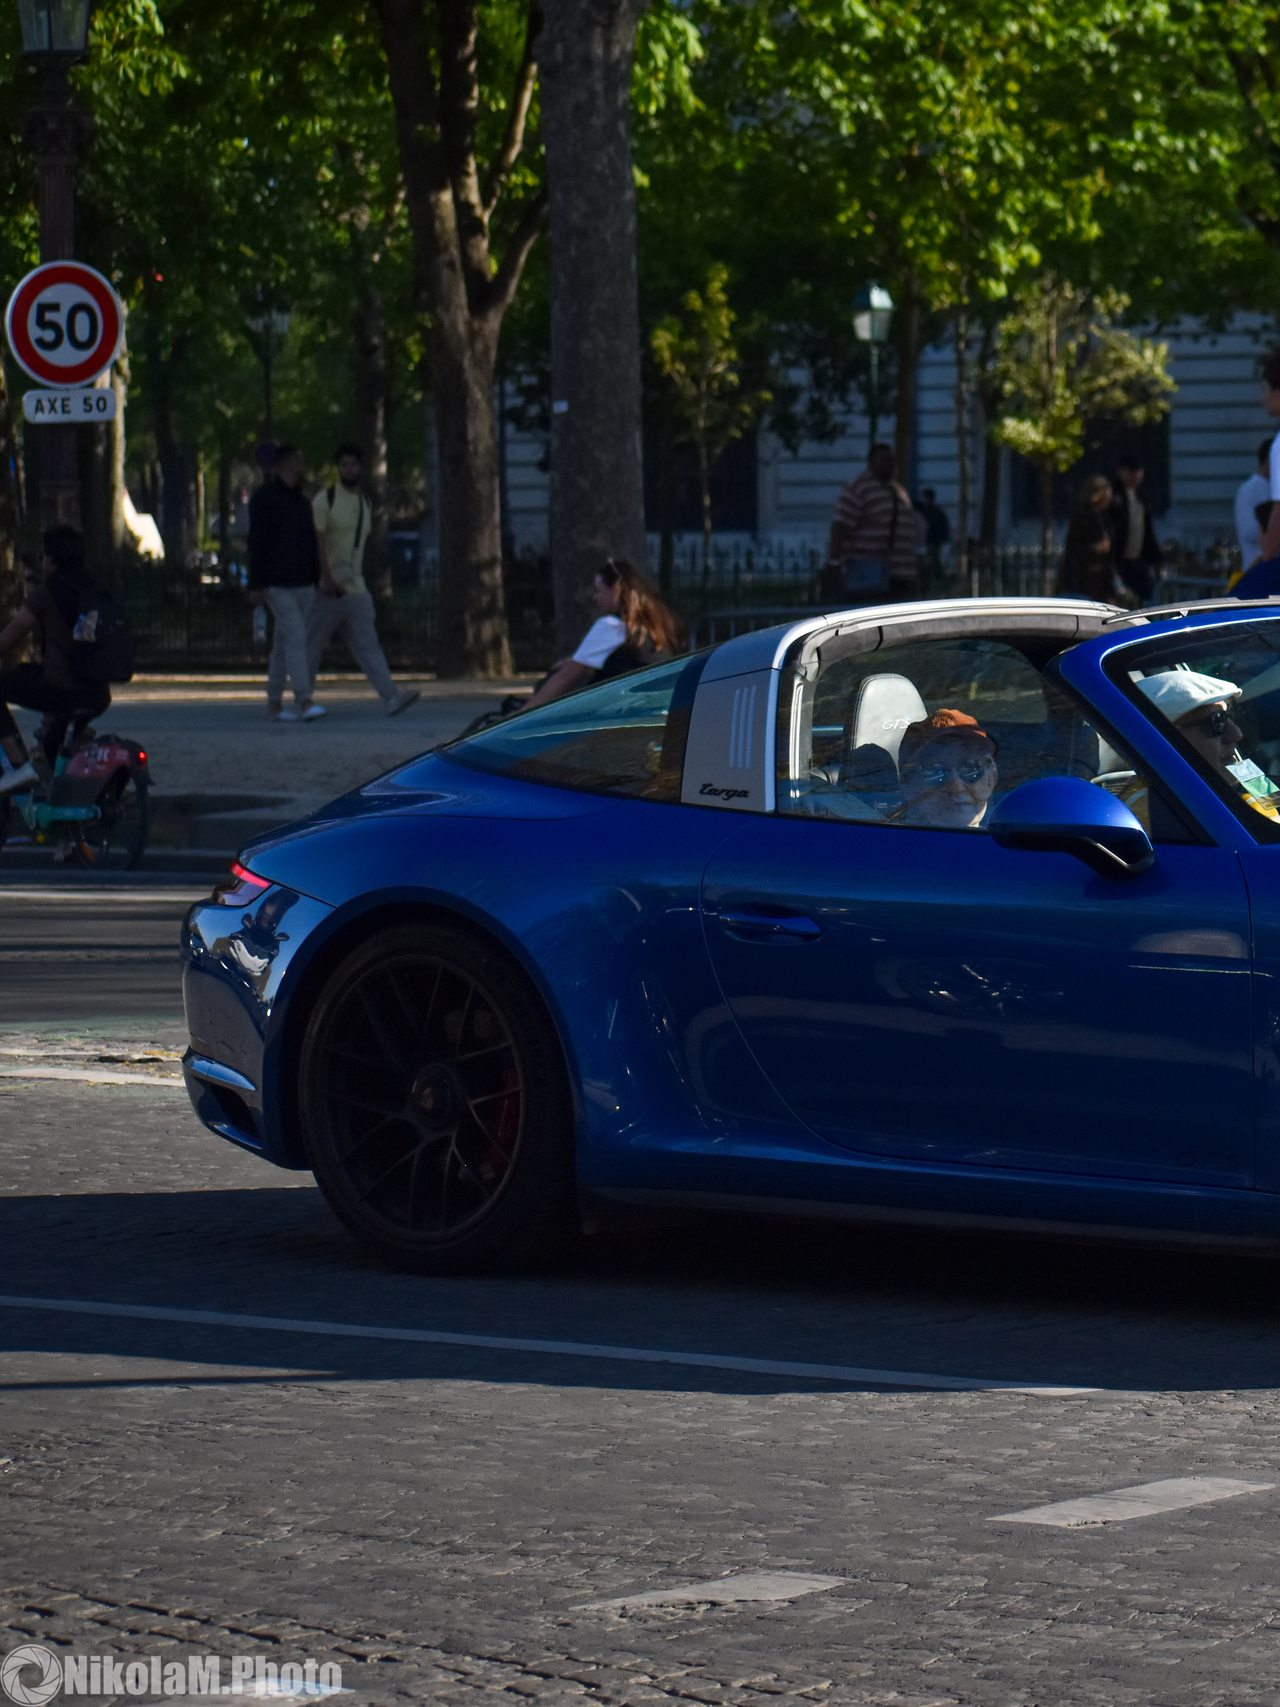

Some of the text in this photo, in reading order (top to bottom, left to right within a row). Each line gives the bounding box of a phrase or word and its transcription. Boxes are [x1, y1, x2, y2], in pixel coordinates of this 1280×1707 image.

[34, 302, 99, 351] 50
[34, 396, 108, 414] AXE 50
[881, 718, 912, 731] GTS
